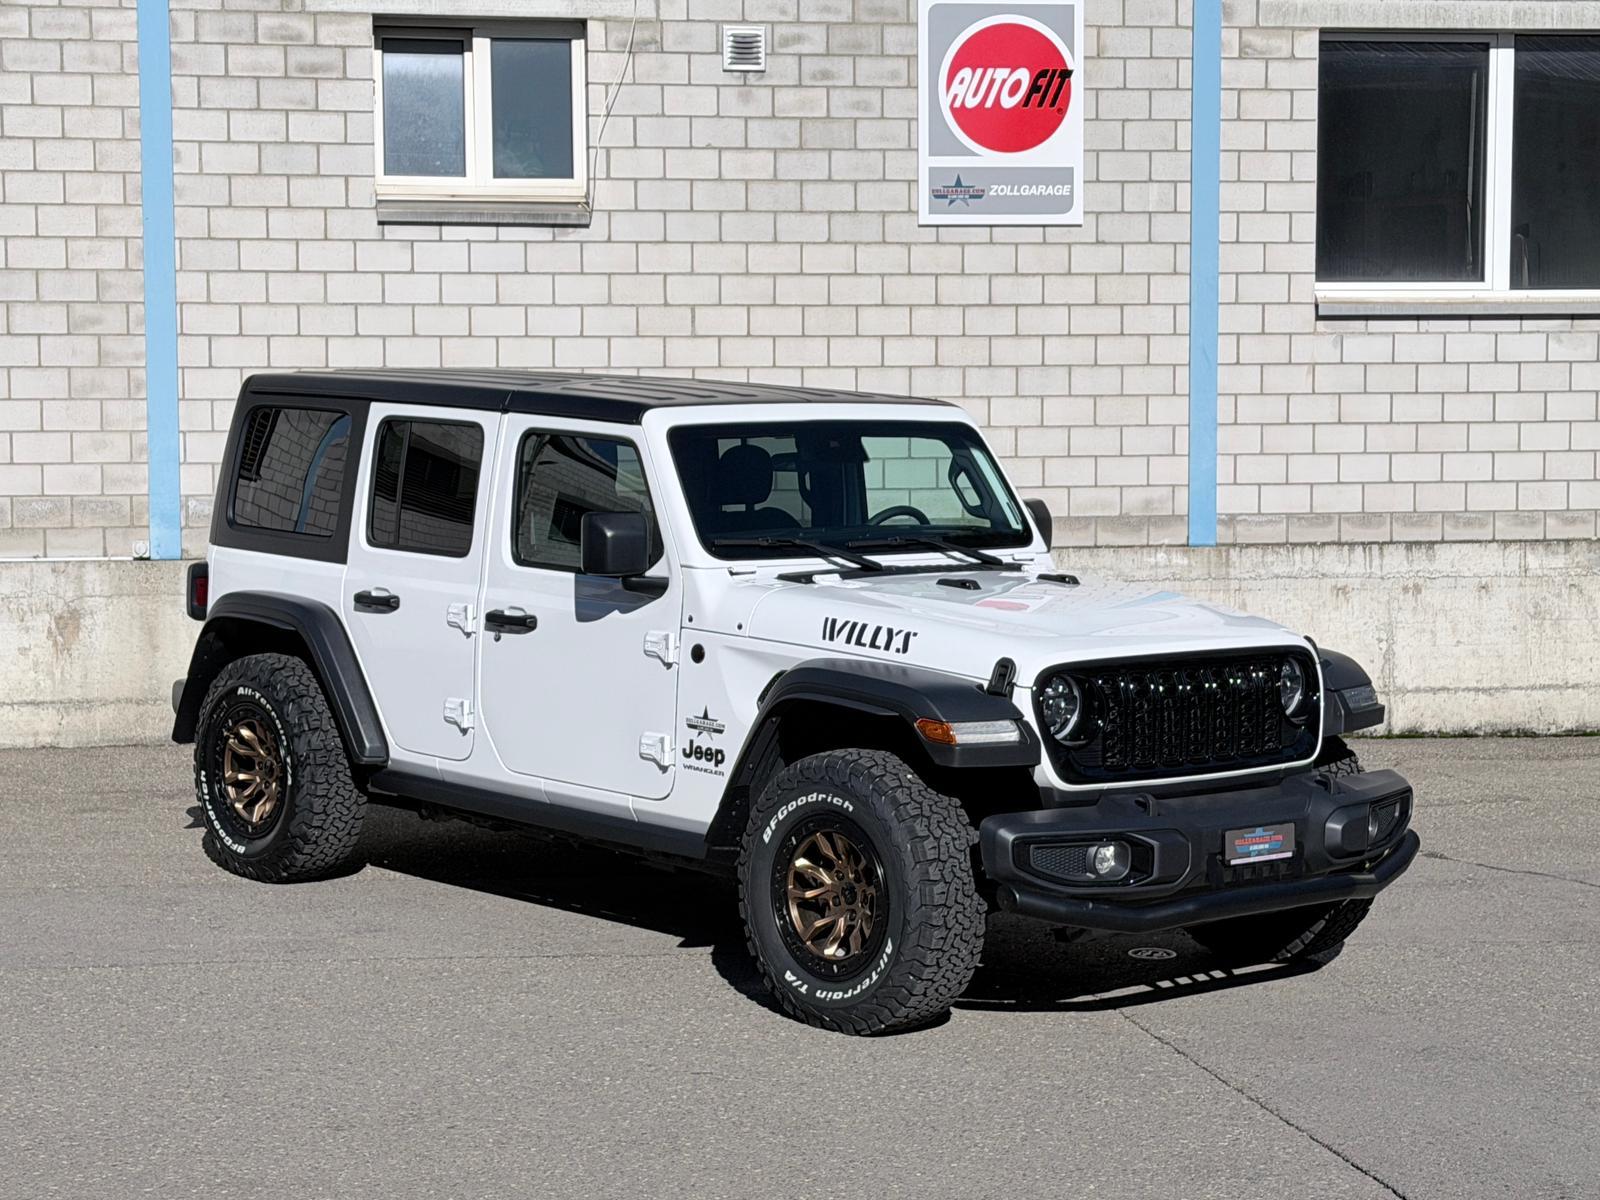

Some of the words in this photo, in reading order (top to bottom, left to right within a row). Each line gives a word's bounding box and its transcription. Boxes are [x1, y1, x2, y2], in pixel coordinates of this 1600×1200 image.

[947, 67, 1074, 109] AUTOFIT
[989, 184, 1071, 196] ZOLLGARAGE
[822, 617, 918, 654] WILLYS
[682, 739, 726, 768] Jeep
[683, 763, 725, 777] WRANGLER
[762, 792, 854, 844] BFGoodrich
[784, 969, 809, 995] T/A
[815, 937, 893, 1001] All-Terrain
